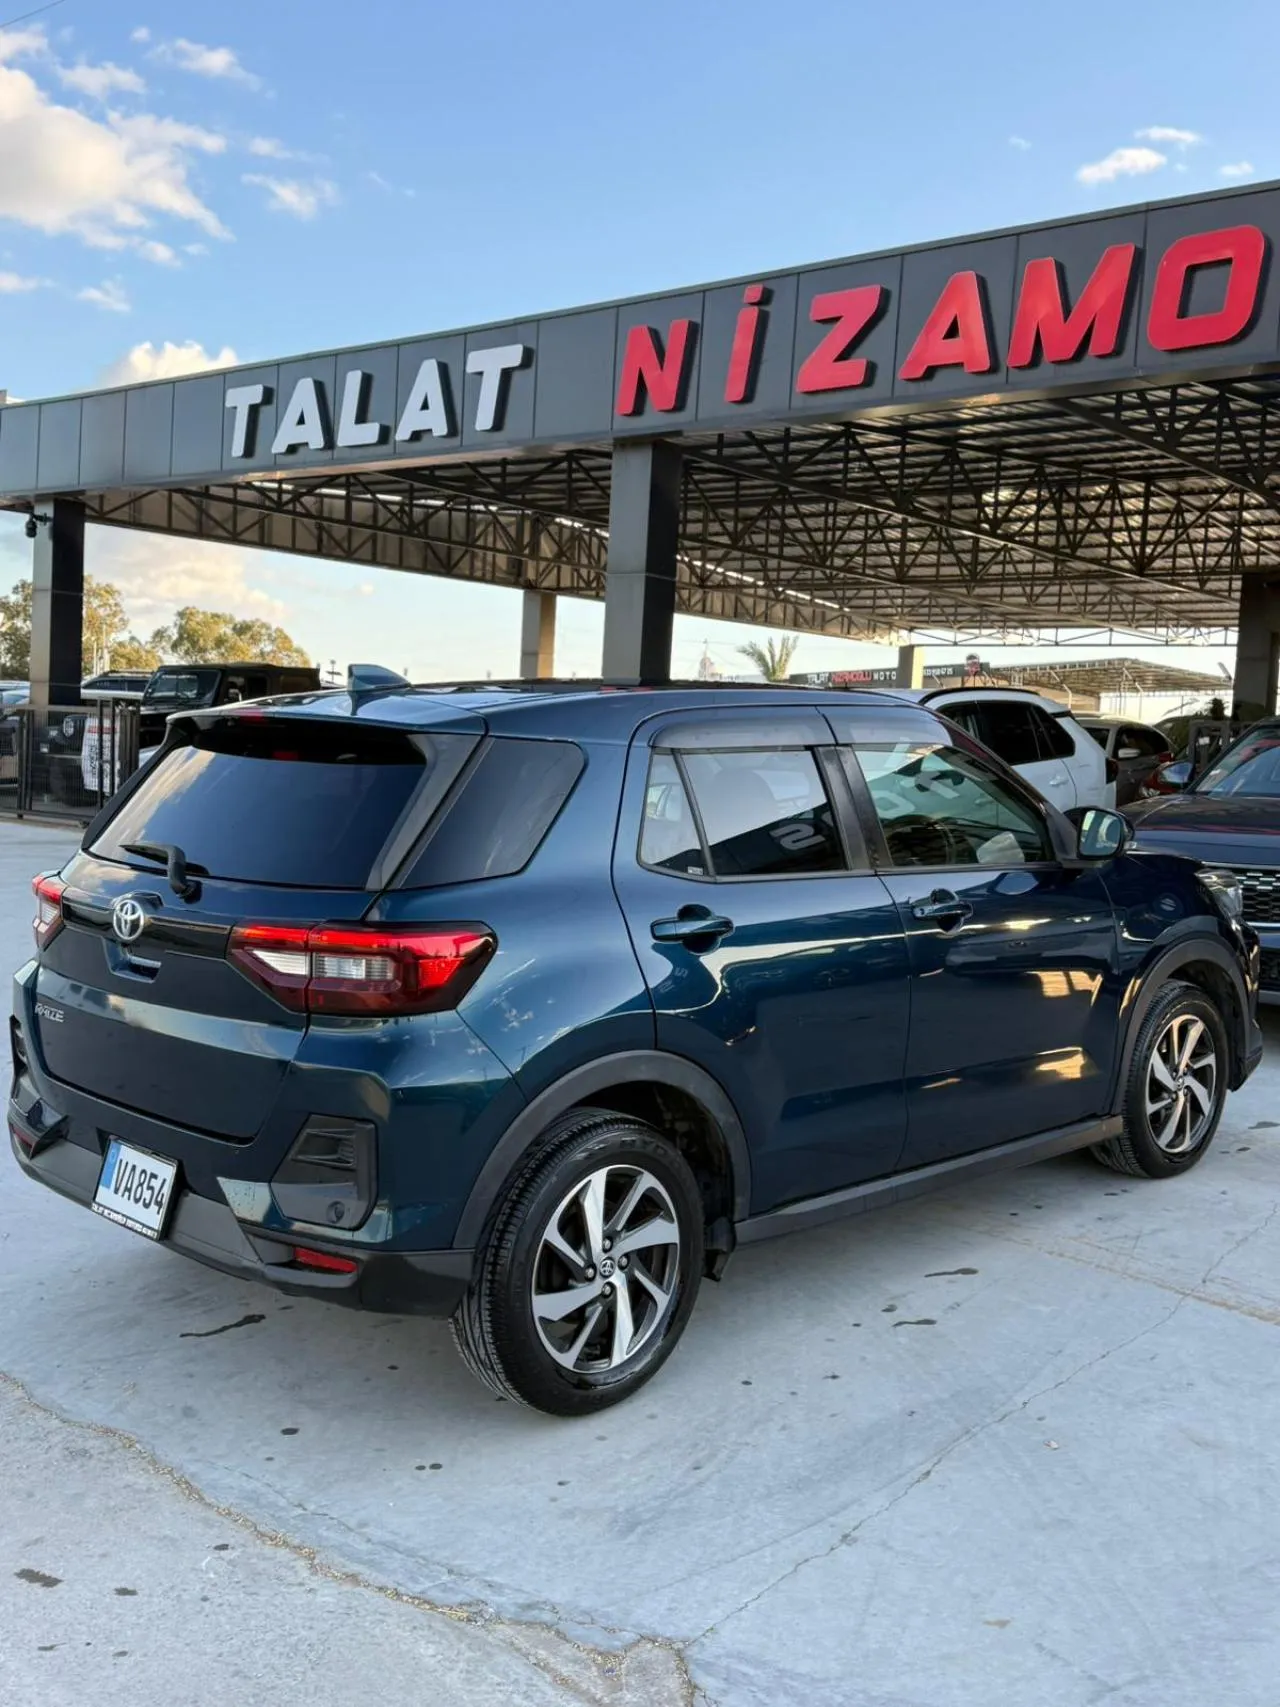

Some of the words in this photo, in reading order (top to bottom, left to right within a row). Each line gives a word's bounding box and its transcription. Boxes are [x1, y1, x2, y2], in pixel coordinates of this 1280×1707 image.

[225, 344, 525, 458] TALAT
[615, 224, 1266, 416] NİZAMO
[873, 670, 897, 681] MOTO
[35, 1002, 64, 1023] RAIZE
[114, 1159, 168, 1215] VA854
